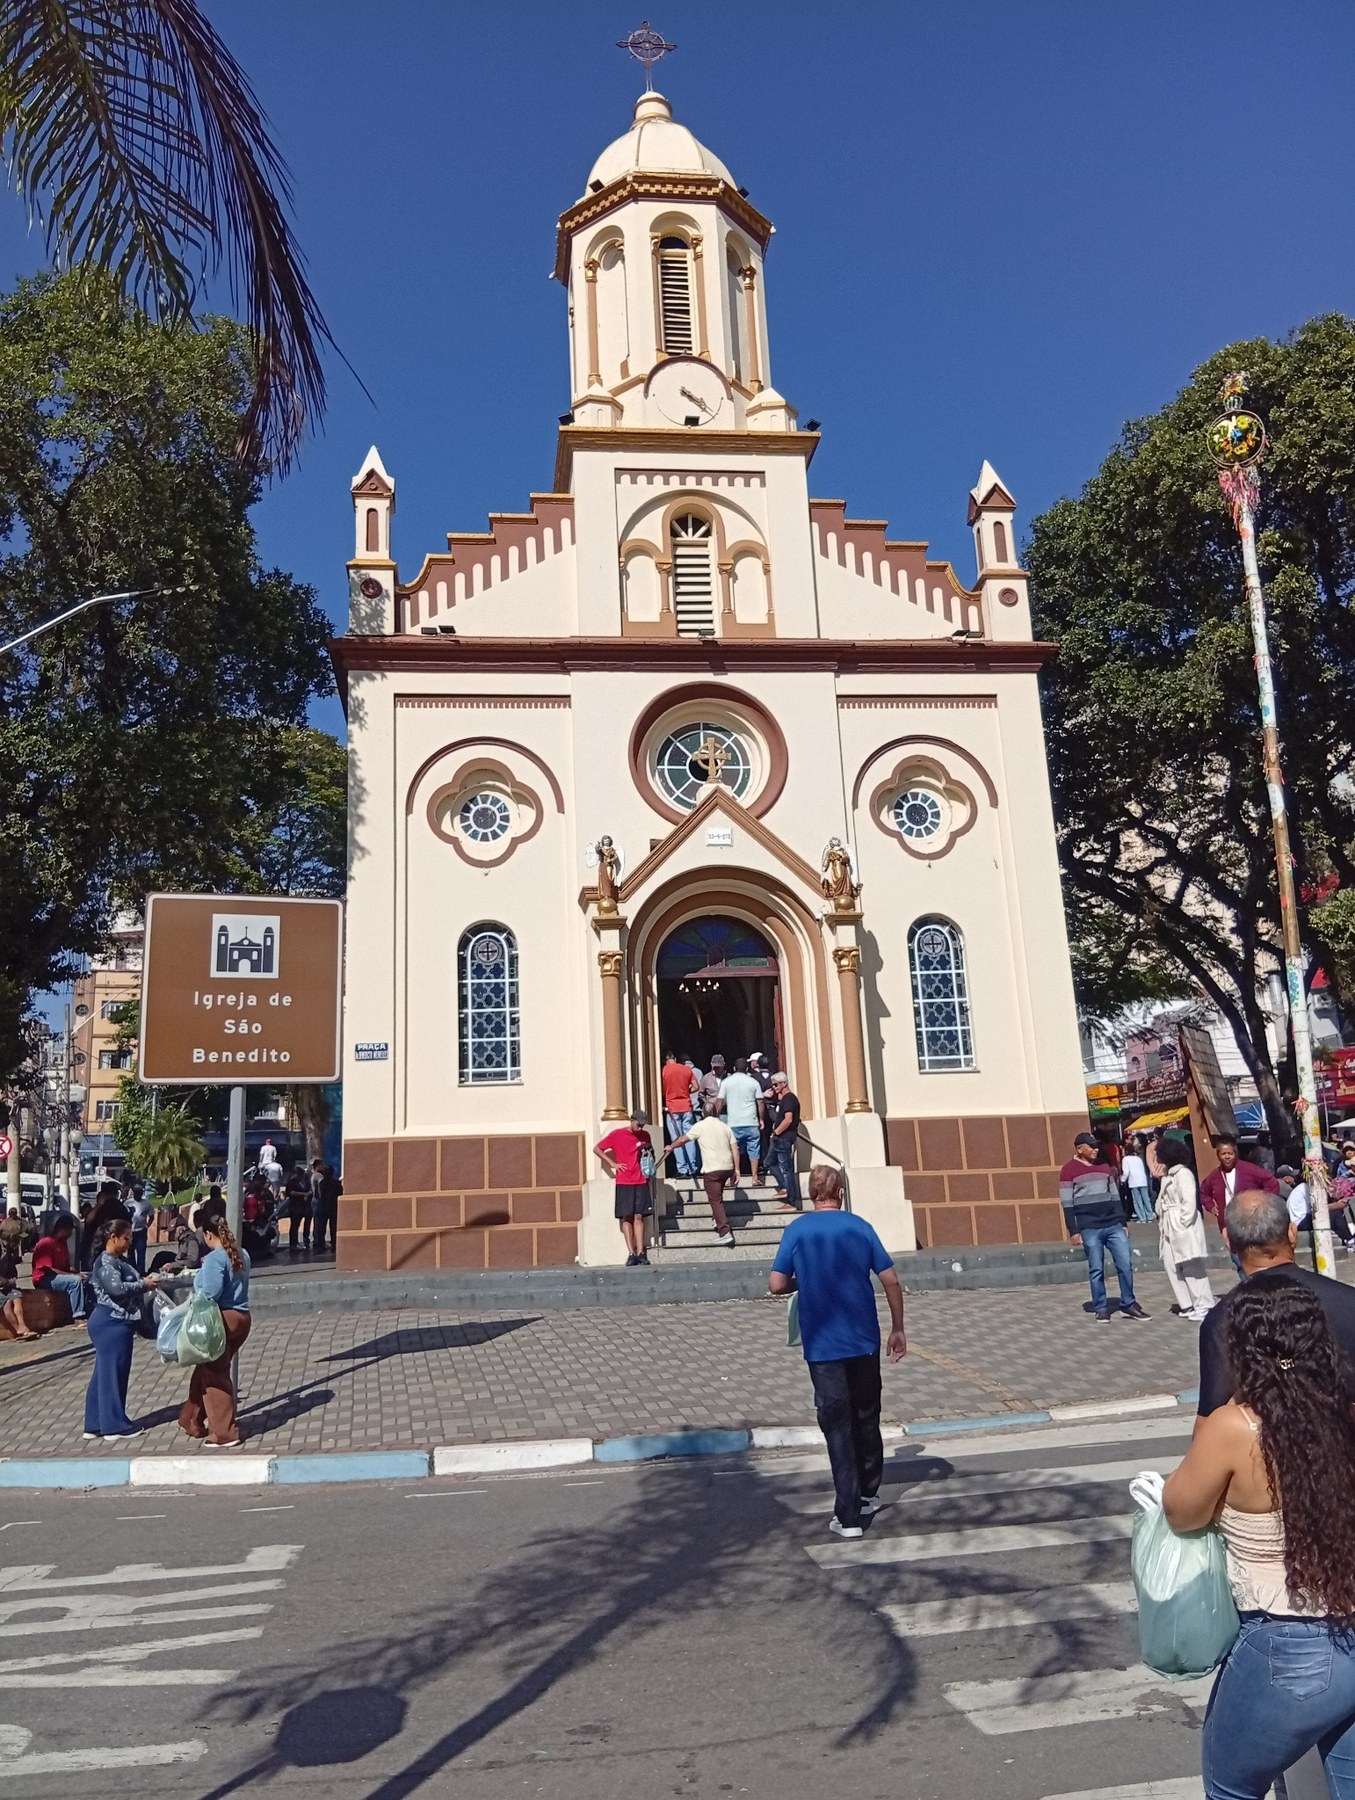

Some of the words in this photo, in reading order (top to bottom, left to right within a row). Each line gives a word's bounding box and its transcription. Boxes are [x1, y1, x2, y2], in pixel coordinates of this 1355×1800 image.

[194, 991, 257, 1010] Igreja
[269, 992, 292, 1006] de
[224, 1019, 262, 1034] São
[192, 1048, 291, 1063] Benedito
